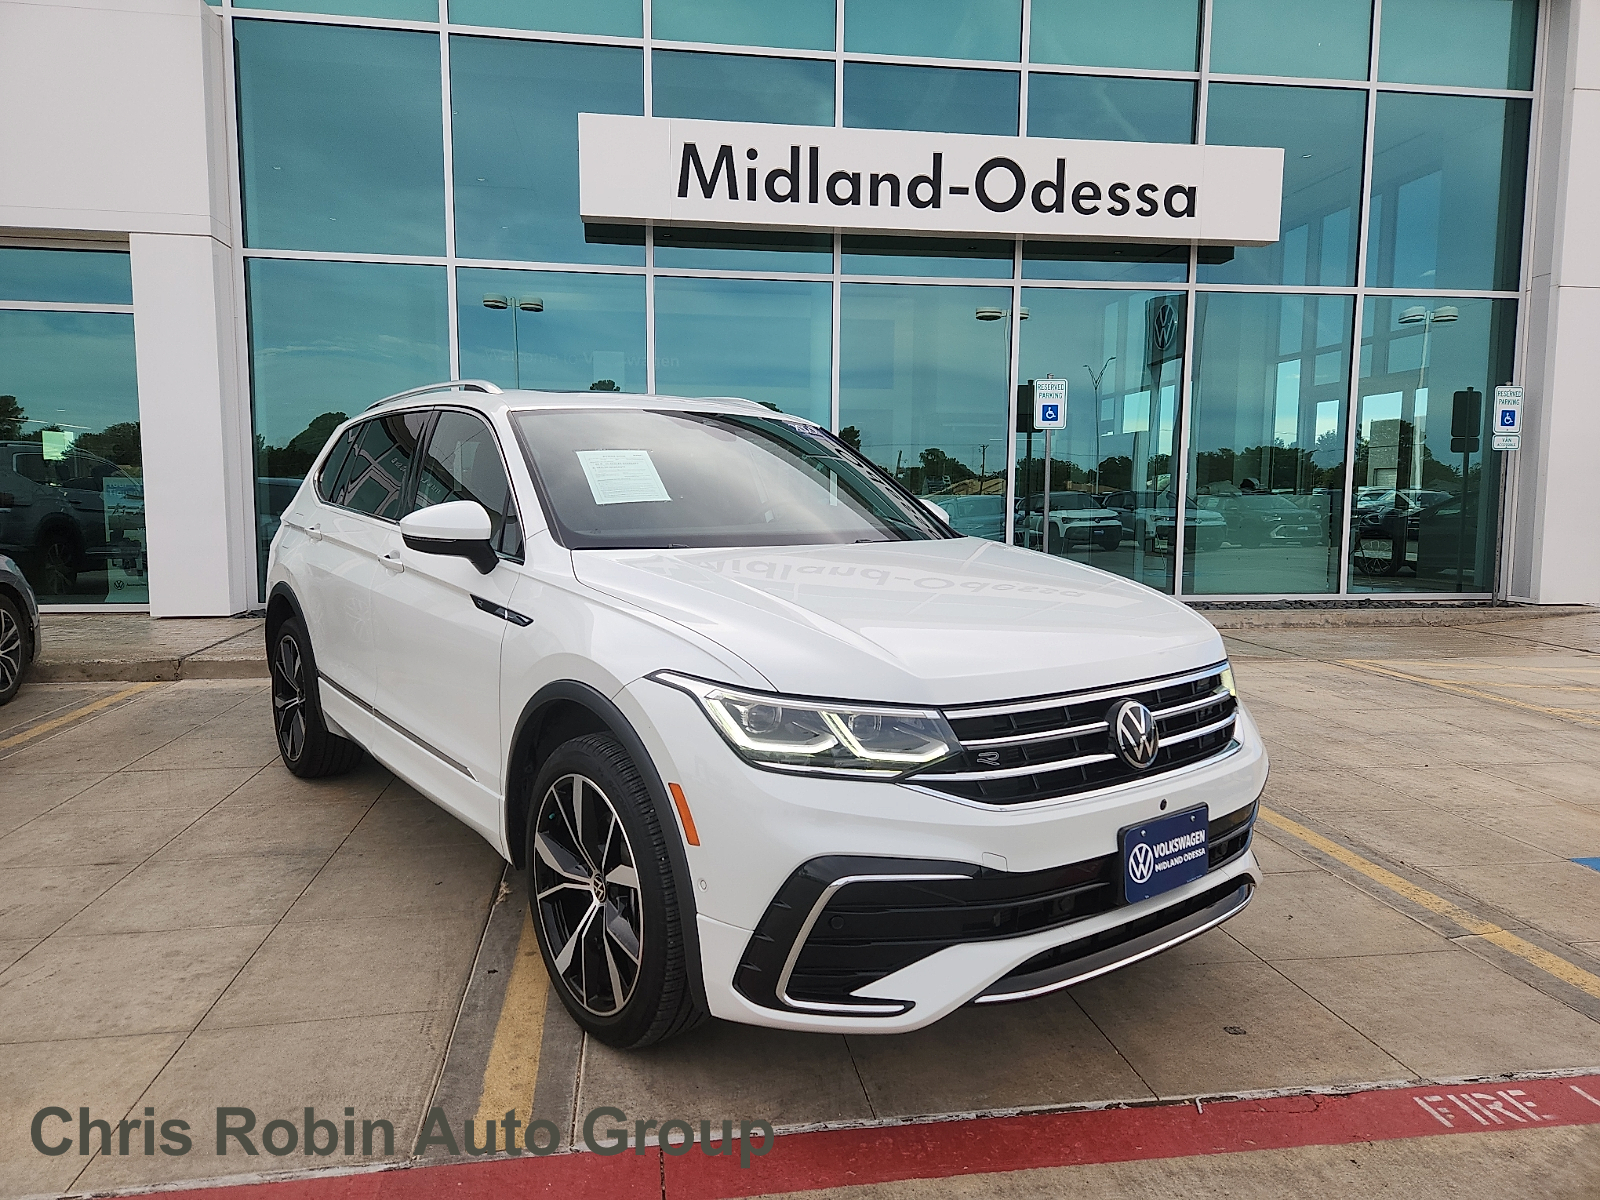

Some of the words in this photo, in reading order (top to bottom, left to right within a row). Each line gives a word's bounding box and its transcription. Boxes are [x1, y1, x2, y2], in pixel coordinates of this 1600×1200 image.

[677, 142, 1198, 218] Midland-Odessa
[1152, 829, 1206, 859] VOLKSWAGEN
[1154, 855, 1184, 872] MIDLAND
[1183, 847, 1206, 862] ODESSA
[1413, 1089, 1557, 1128] FIRE
